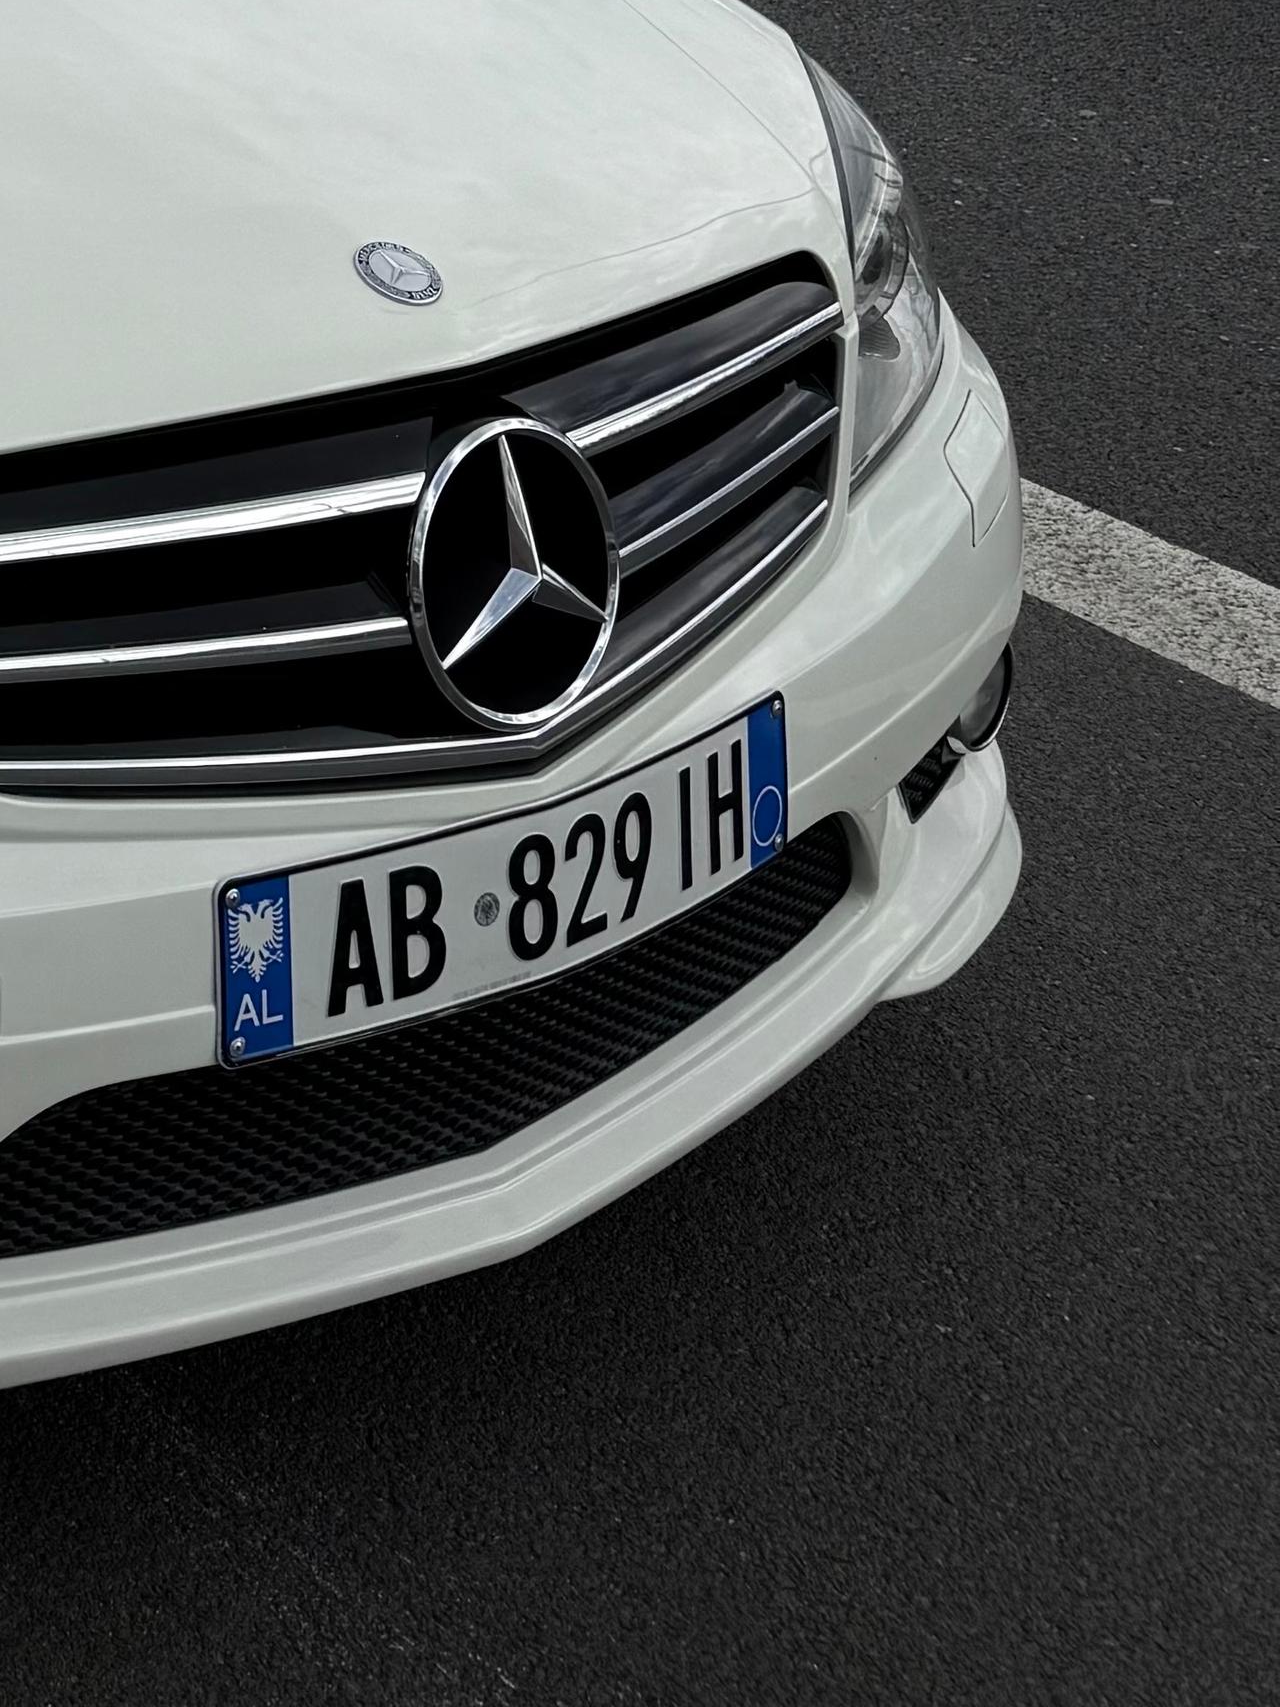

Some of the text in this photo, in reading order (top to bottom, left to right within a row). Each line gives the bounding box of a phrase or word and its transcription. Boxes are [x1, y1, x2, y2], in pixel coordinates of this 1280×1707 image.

[327, 740, 744, 1018] AB 829 IH
[234, 992, 284, 1030] AL
